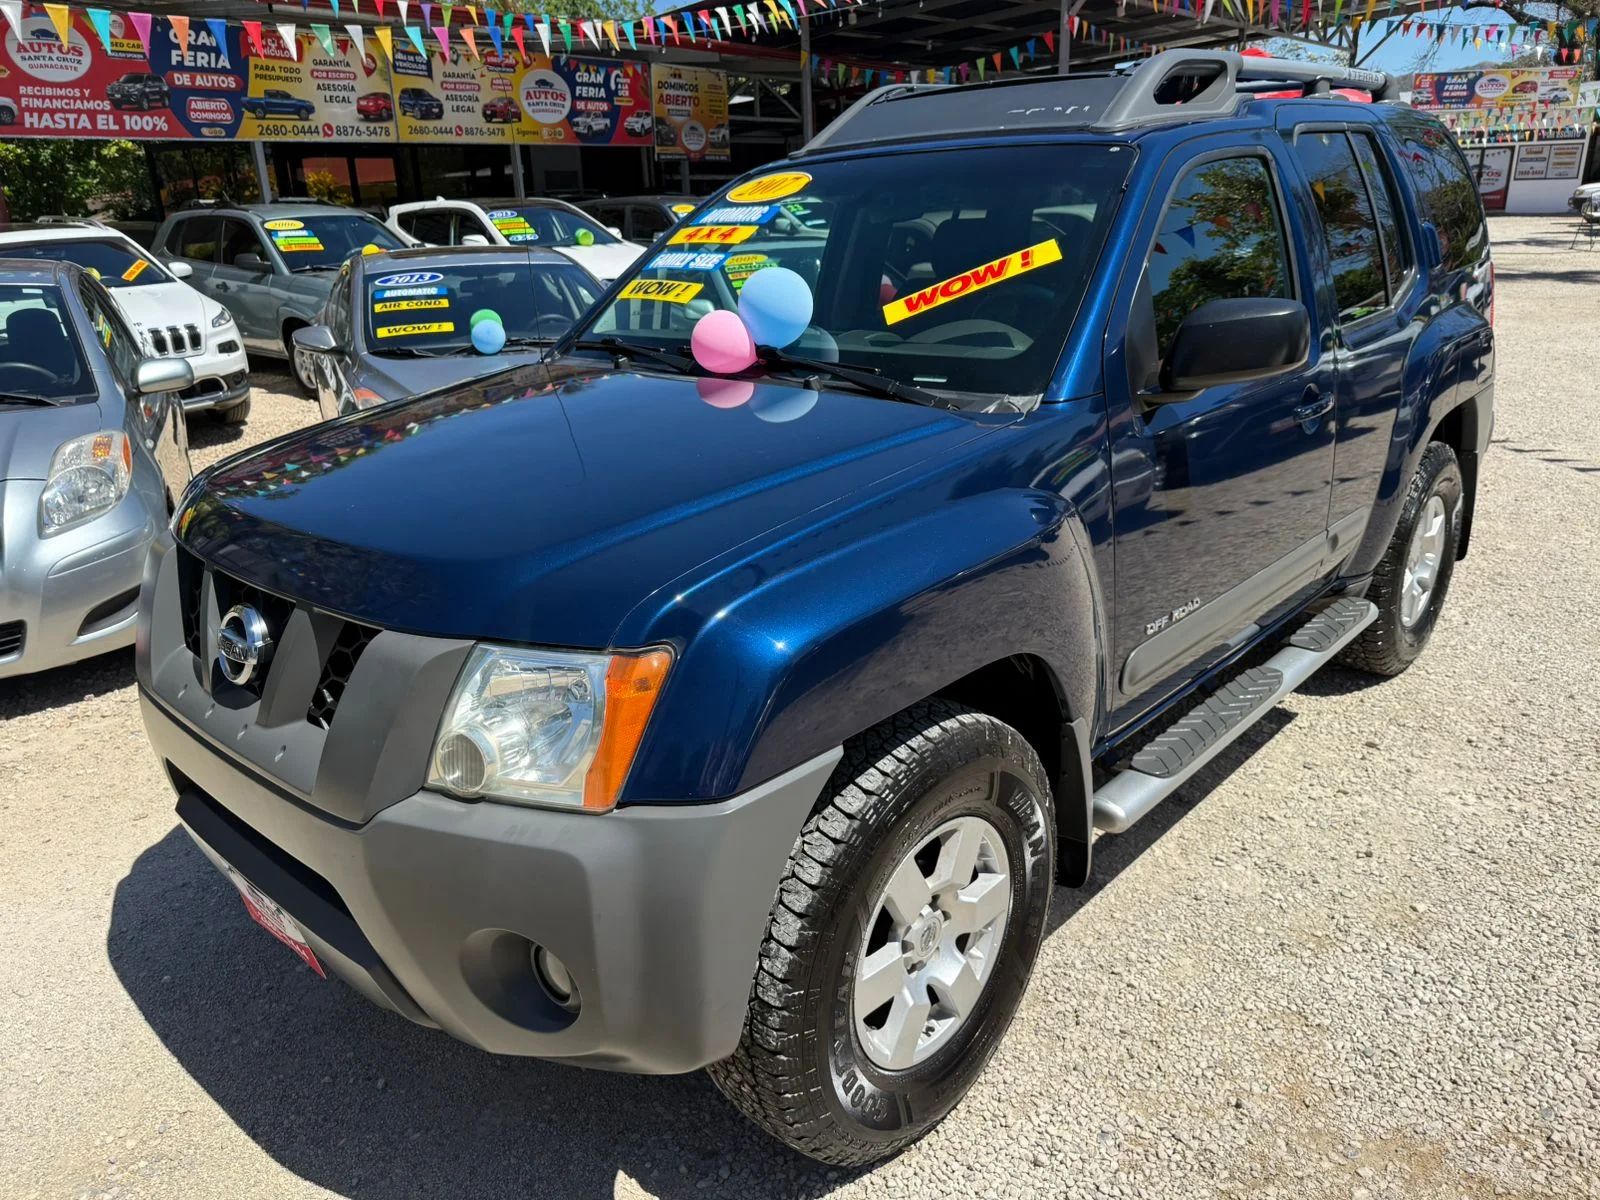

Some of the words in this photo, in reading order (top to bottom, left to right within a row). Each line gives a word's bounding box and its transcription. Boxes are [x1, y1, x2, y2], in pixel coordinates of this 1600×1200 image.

[16, 42, 84, 57] AUTOS
[250, 45, 295, 57] VHÍCULO
[56, 56, 83, 65] CRUZ
[171, 50, 231, 69] FERIA
[312, 58, 351, 68] GARANTÍA
[28, 64, 79, 72] GUANACASTE
[254, 64, 276, 72] PARA
[279, 66, 301, 75] TODO
[173, 73, 191, 86] DE
[195, 75, 236, 88] AUTOS
[255, 74, 302, 83] PRESUPUESTO
[442, 71, 477, 80] GARANTÍA
[575, 72, 604, 84] GRAN
[19, 86, 81, 97] RECIBIMOS
[83, 89, 91, 97] Y
[317, 82, 356, 92] ASESORÍA
[576, 86, 606, 98] FERIA
[657, 81, 699, 93] DOMINGOS
[324, 94, 352, 104] LEGAL
[445, 93, 480, 103] ASESORÍA
[525, 89, 567, 102] AUTOS
[657, 94, 700, 107] ABIERTO
[21, 97, 112, 111] FINANCIAMOS
[191, 102, 228, 111] ABIERTO
[452, 105, 477, 113] LEGAL
[576, 102, 585, 110] DE
[587, 102, 608, 111] AUTOS
[24, 112, 92, 129] HASTA
[96, 114, 119, 130] EL
[123, 115, 169, 131] 100%
[190, 111, 232, 121] DOMINGOS
[257, 124, 320, 136] 2680-0444
[335, 125, 391, 137] 8876-5478
[408, 125, 454, 136] 2680-0444
[465, 127, 506, 137] 8876-5478
[700, 205, 770, 223] AUTOMATIC
[648, 252, 696, 268] FAMILY
[688, 253, 726, 268] SIZE
[389, 273, 432, 283] 2013
[384, 287, 438, 297] AUTOMATIC
[379, 302, 402, 310] AIR
[1145, 615, 1169, 635] OFF
[1170, 597, 1201, 621] ROAD
